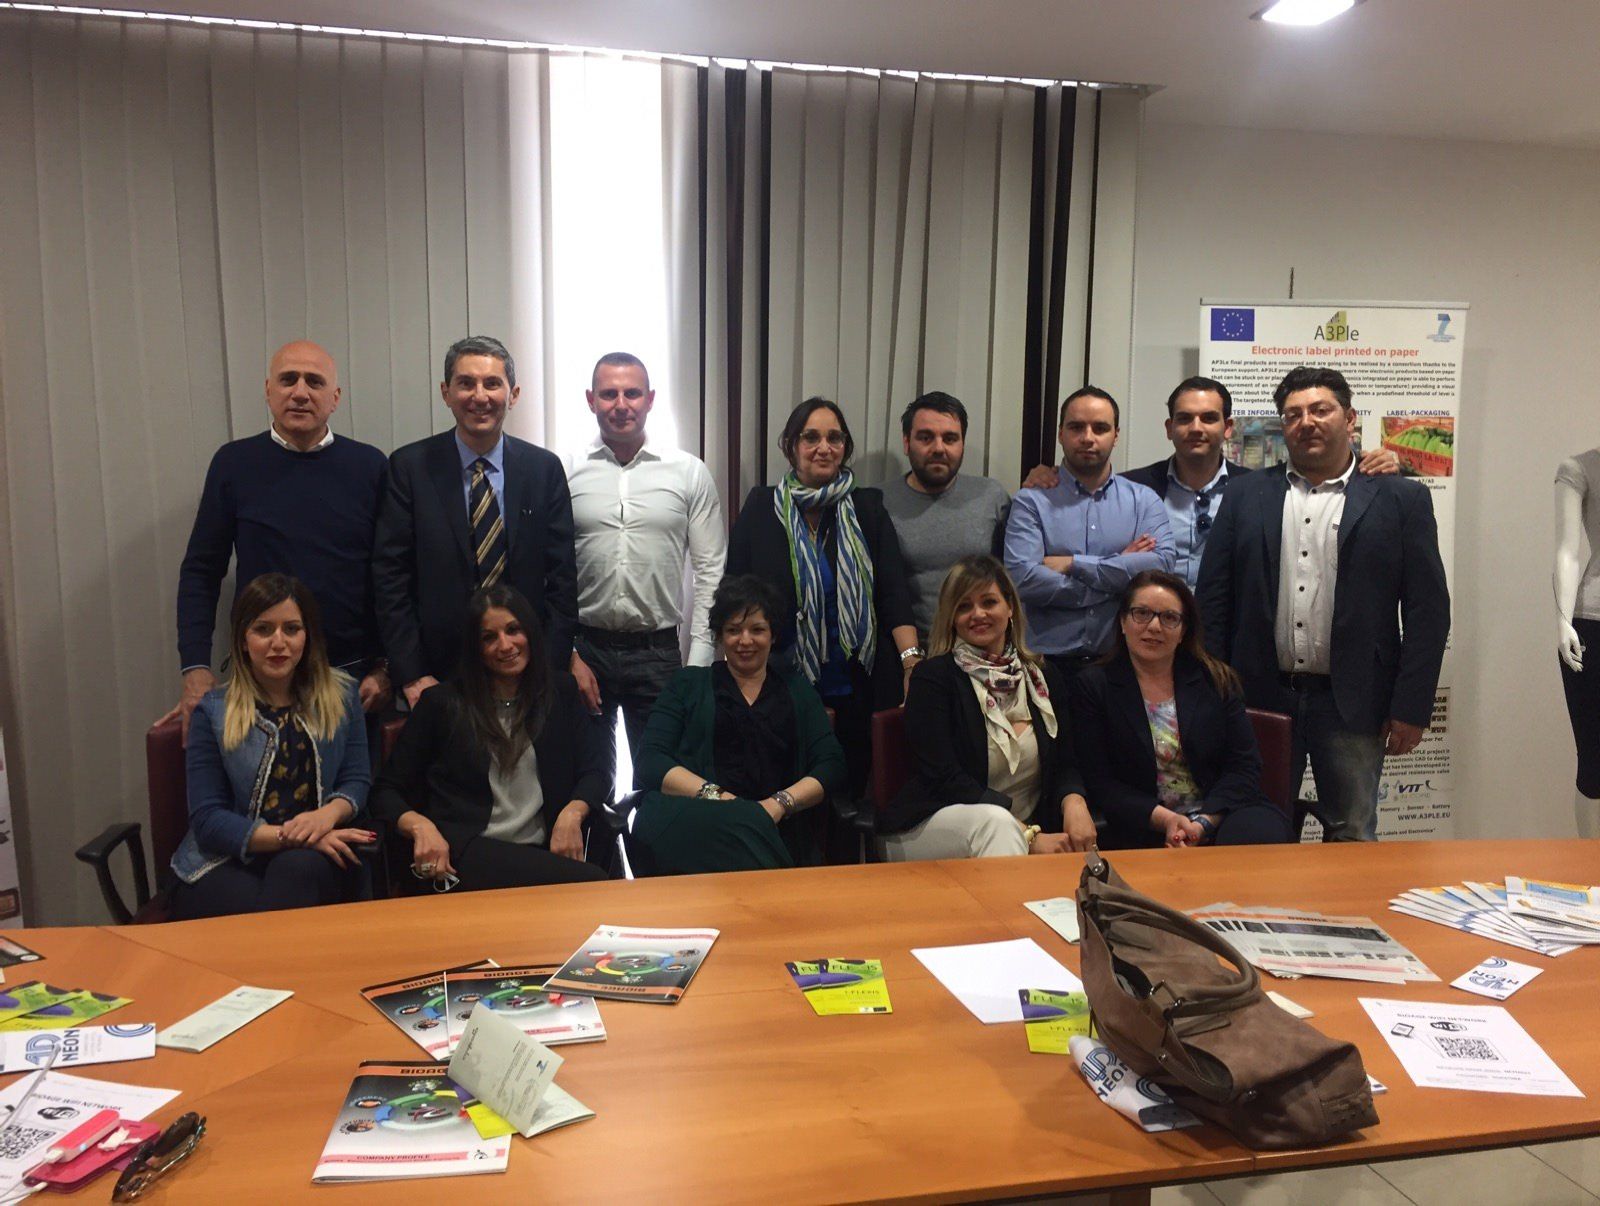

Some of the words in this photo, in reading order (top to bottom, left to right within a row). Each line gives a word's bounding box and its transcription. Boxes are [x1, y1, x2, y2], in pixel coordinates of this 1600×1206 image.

[1314, 324, 1360, 342] A3Ple
[1252, 346, 1303, 355] Electronic
[1306, 346, 1332, 355] label
[1334, 347, 1372, 357] printed
[1374, 348, 1387, 356] on
[1390, 348, 1420, 358] paper
[1398, 784, 1424, 794] VTT
[1472, 970, 1520, 985] NEON
[62, 1029, 80, 1062] NEON
